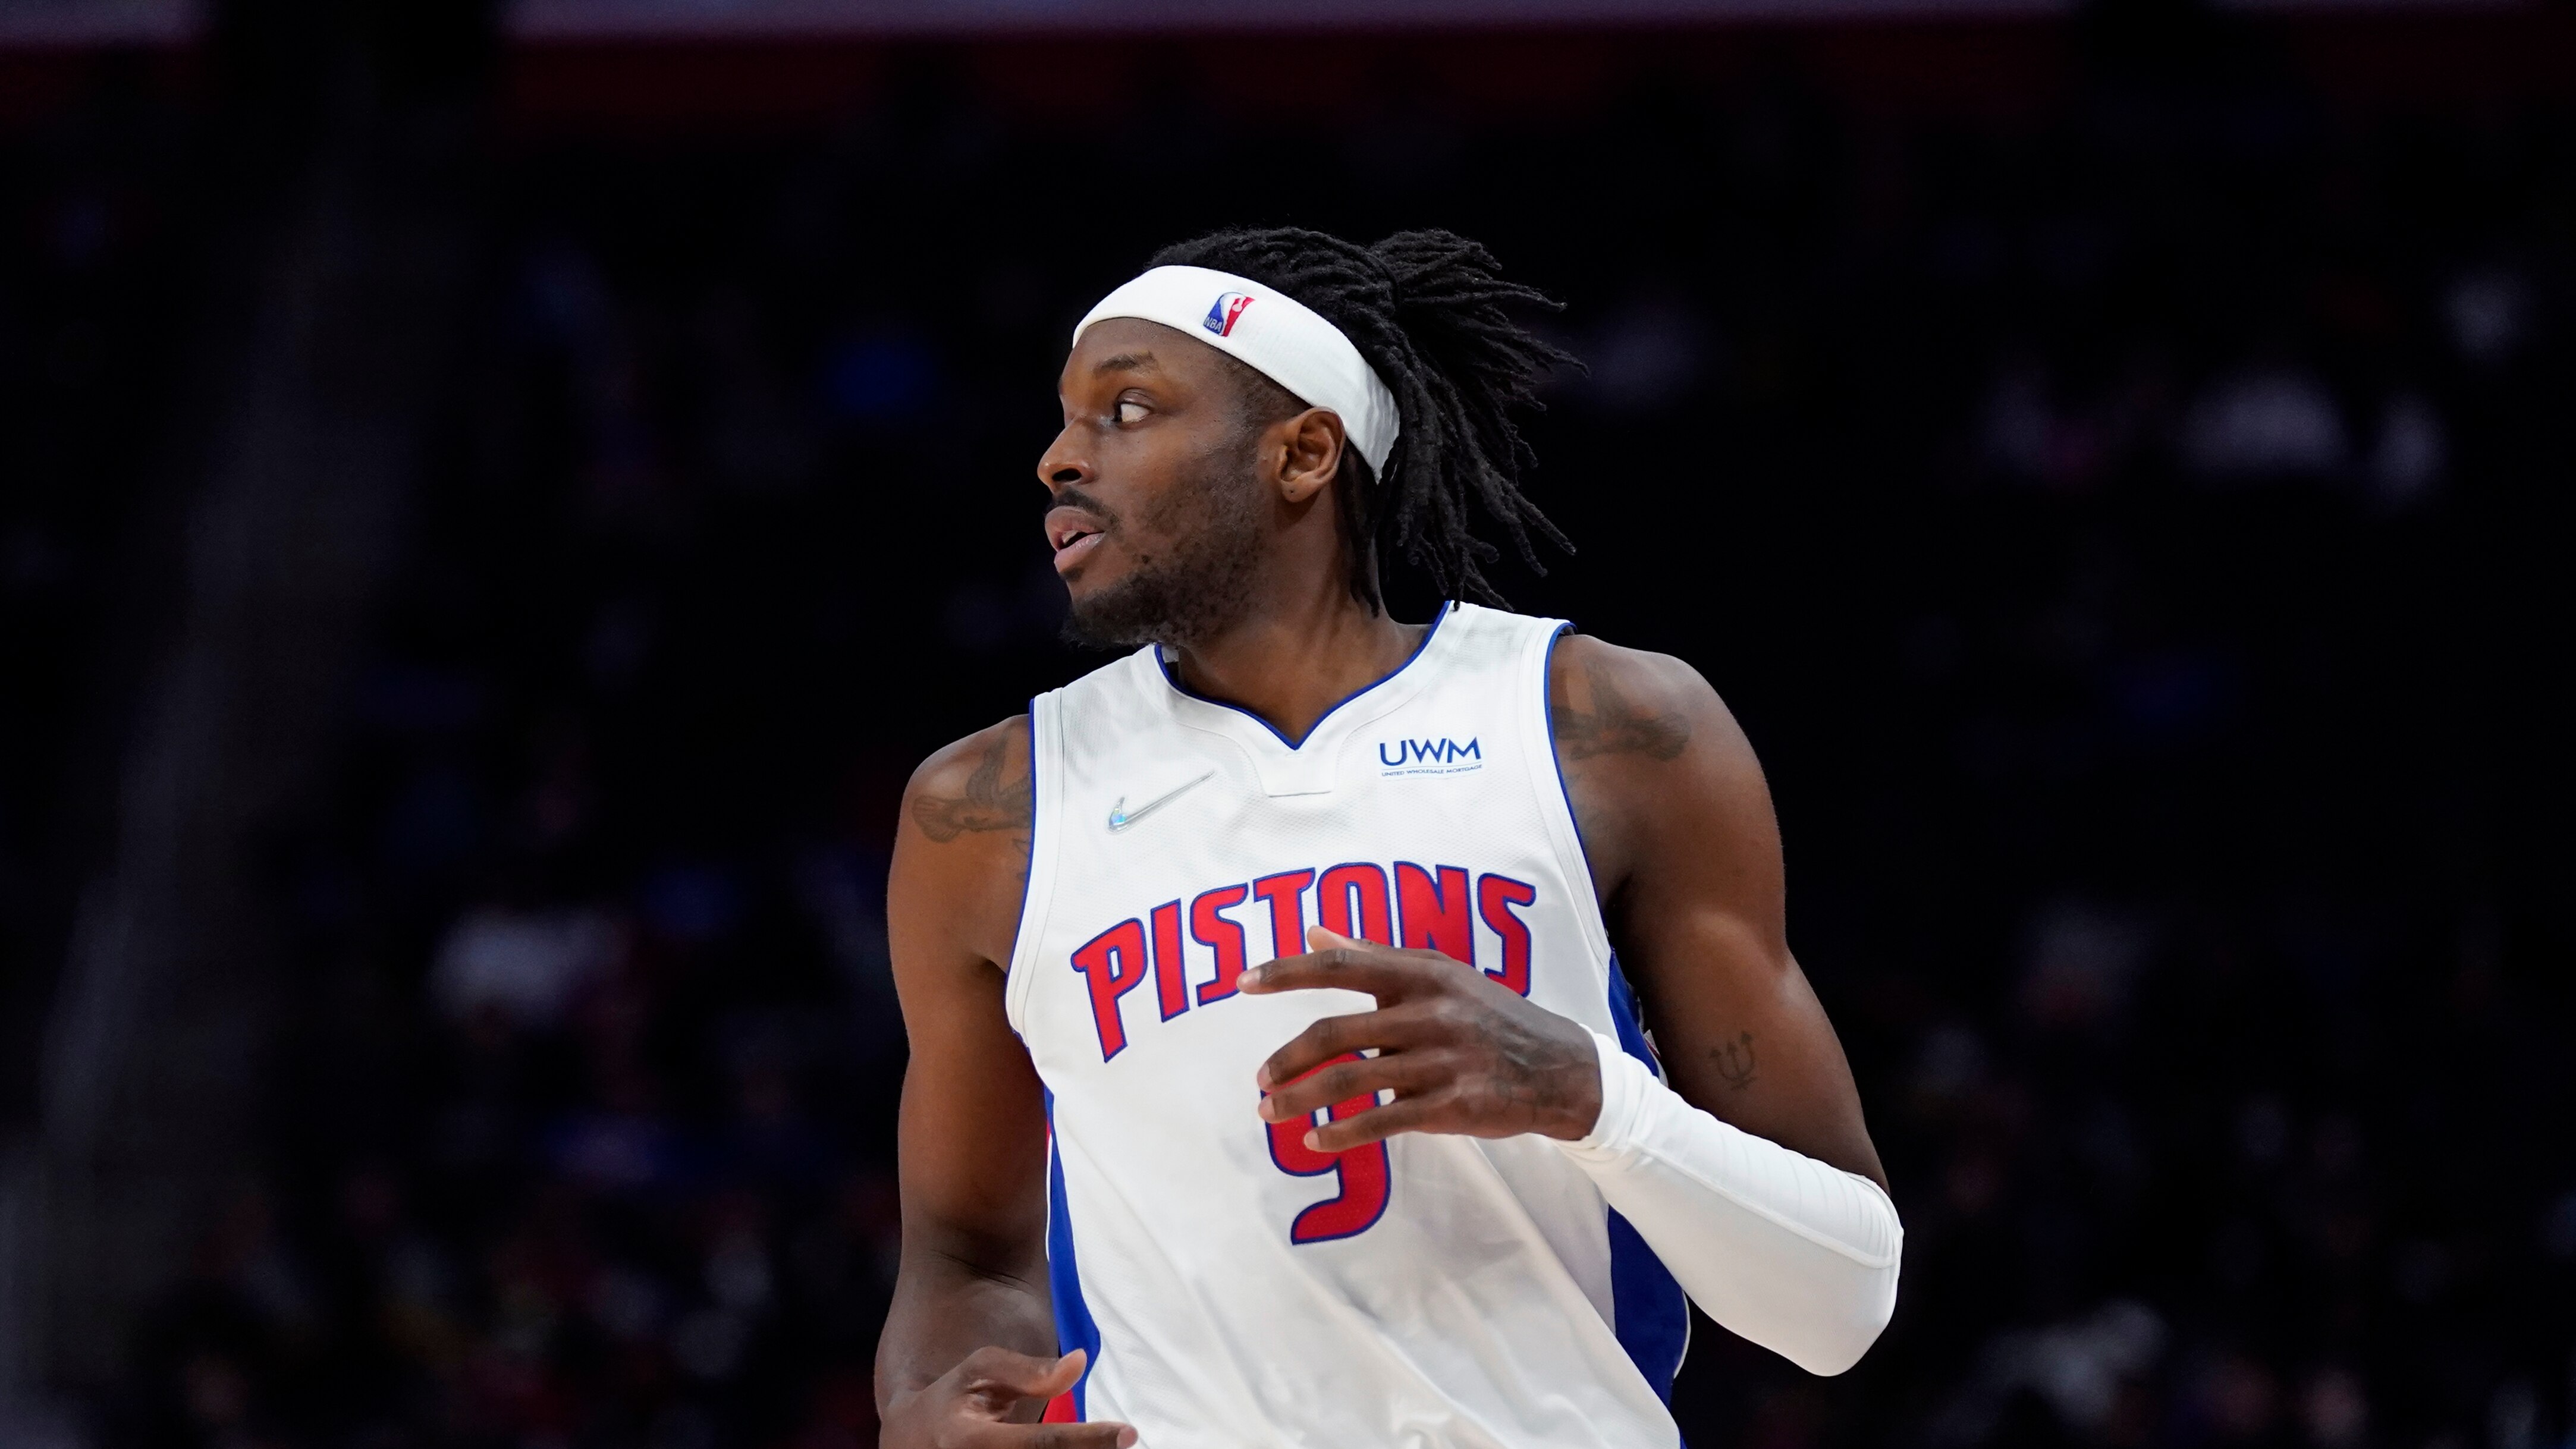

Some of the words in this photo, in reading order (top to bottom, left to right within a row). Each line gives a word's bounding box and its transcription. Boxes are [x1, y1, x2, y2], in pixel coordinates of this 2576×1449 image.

[1204, 317, 1223, 332] NBA
[1380, 737, 1481, 766] UWM
[1446, 765, 1482, 774] MORTGAGE
[1071, 861, 1536, 1063] PISTONS
[1259, 1050, 1391, 1246] 9
